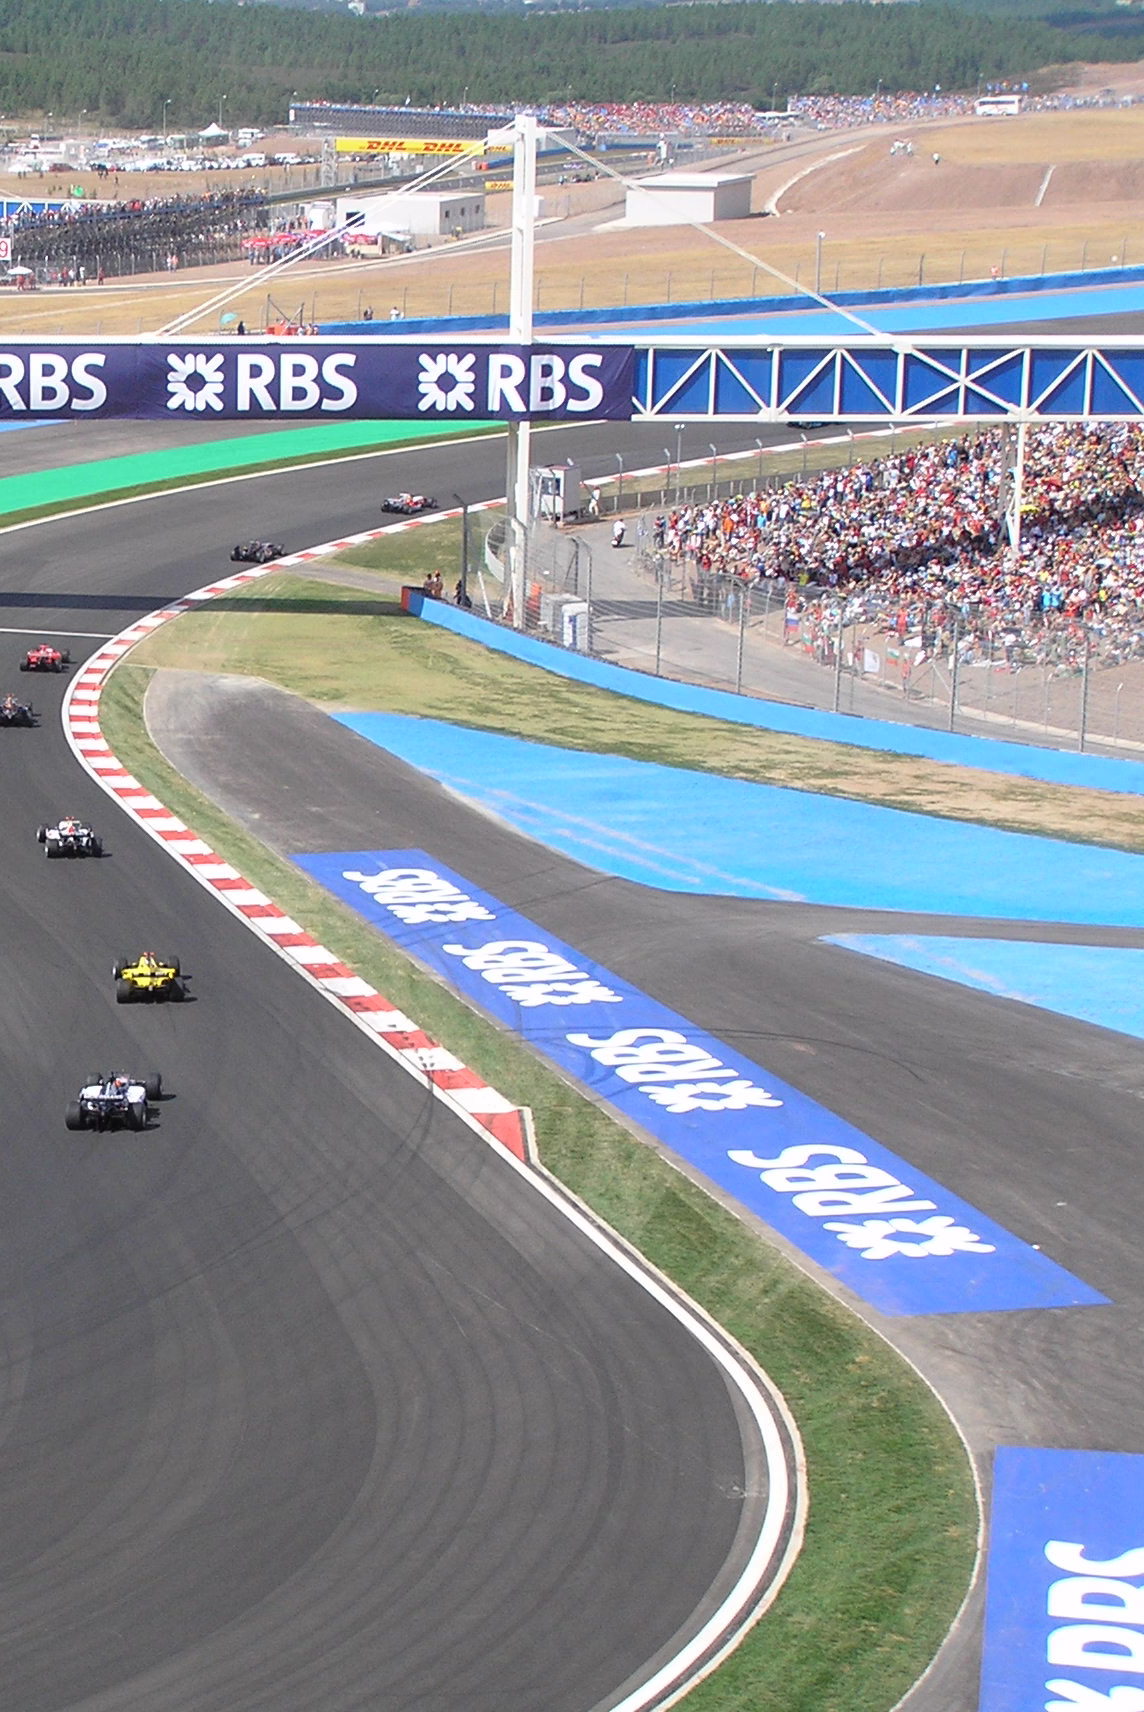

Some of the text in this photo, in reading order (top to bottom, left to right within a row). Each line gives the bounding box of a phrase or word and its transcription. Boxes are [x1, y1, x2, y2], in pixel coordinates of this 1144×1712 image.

[366, 141, 406, 150] DHL
[423, 142, 464, 152] DHL
[238, 353, 358, 411] RBS
[488, 353, 604, 412] RBS
[343, 868, 471, 904] RBS
[443, 940, 590, 984] RBS
[567, 1028, 740, 1083] RBS
[728, 1144, 937, 1217] RBS
